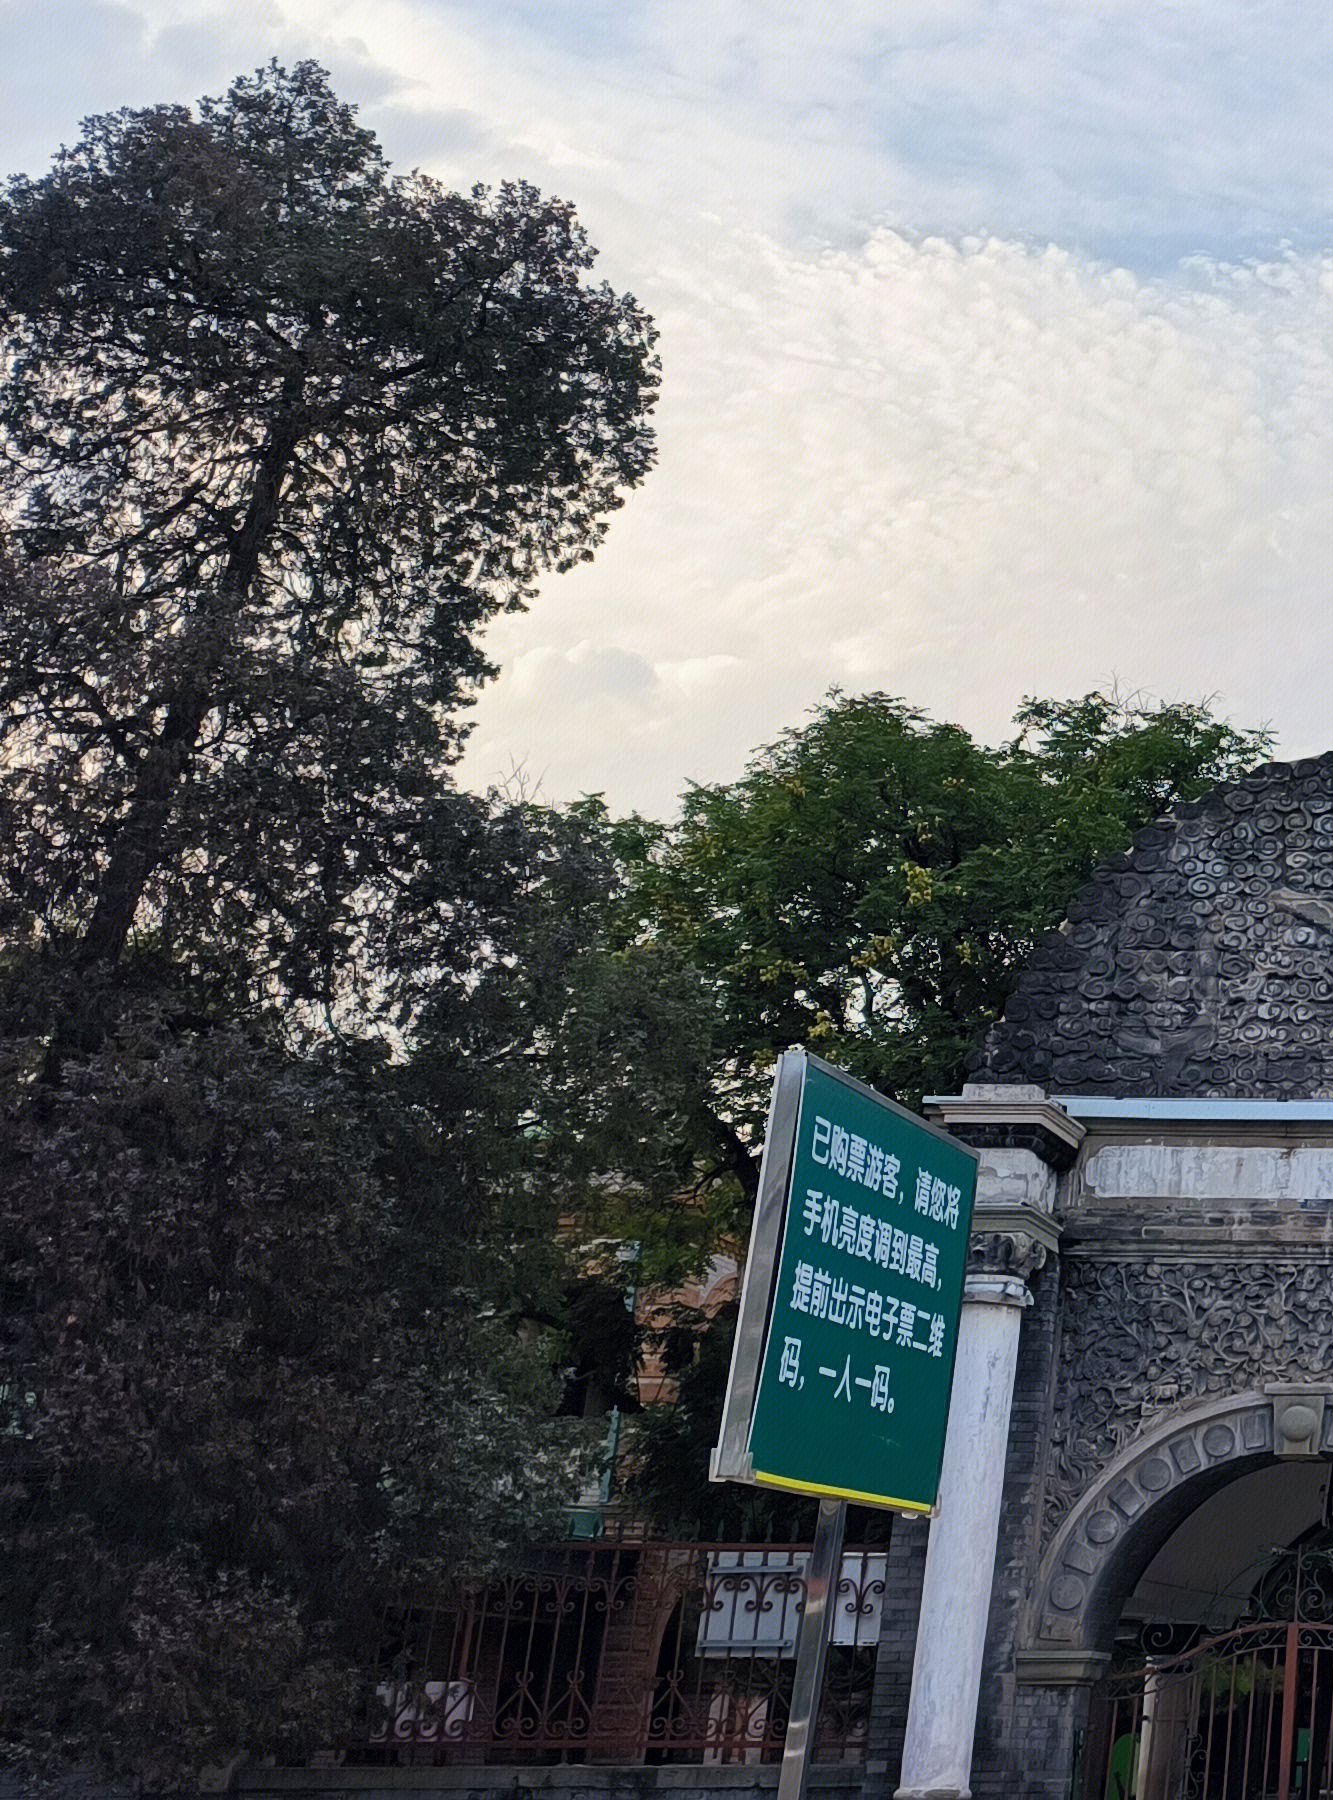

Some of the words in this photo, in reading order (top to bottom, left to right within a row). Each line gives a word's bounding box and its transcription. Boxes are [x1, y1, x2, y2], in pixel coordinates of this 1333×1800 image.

[811, 1115, 961, 1230] 已购票游客，请您将
[803, 1188, 942, 1291] 手机亮度调到最高，
[789, 1259, 946, 1358] 提前出示电子票二维
[779, 1335, 895, 1414] 码，一人一码。
